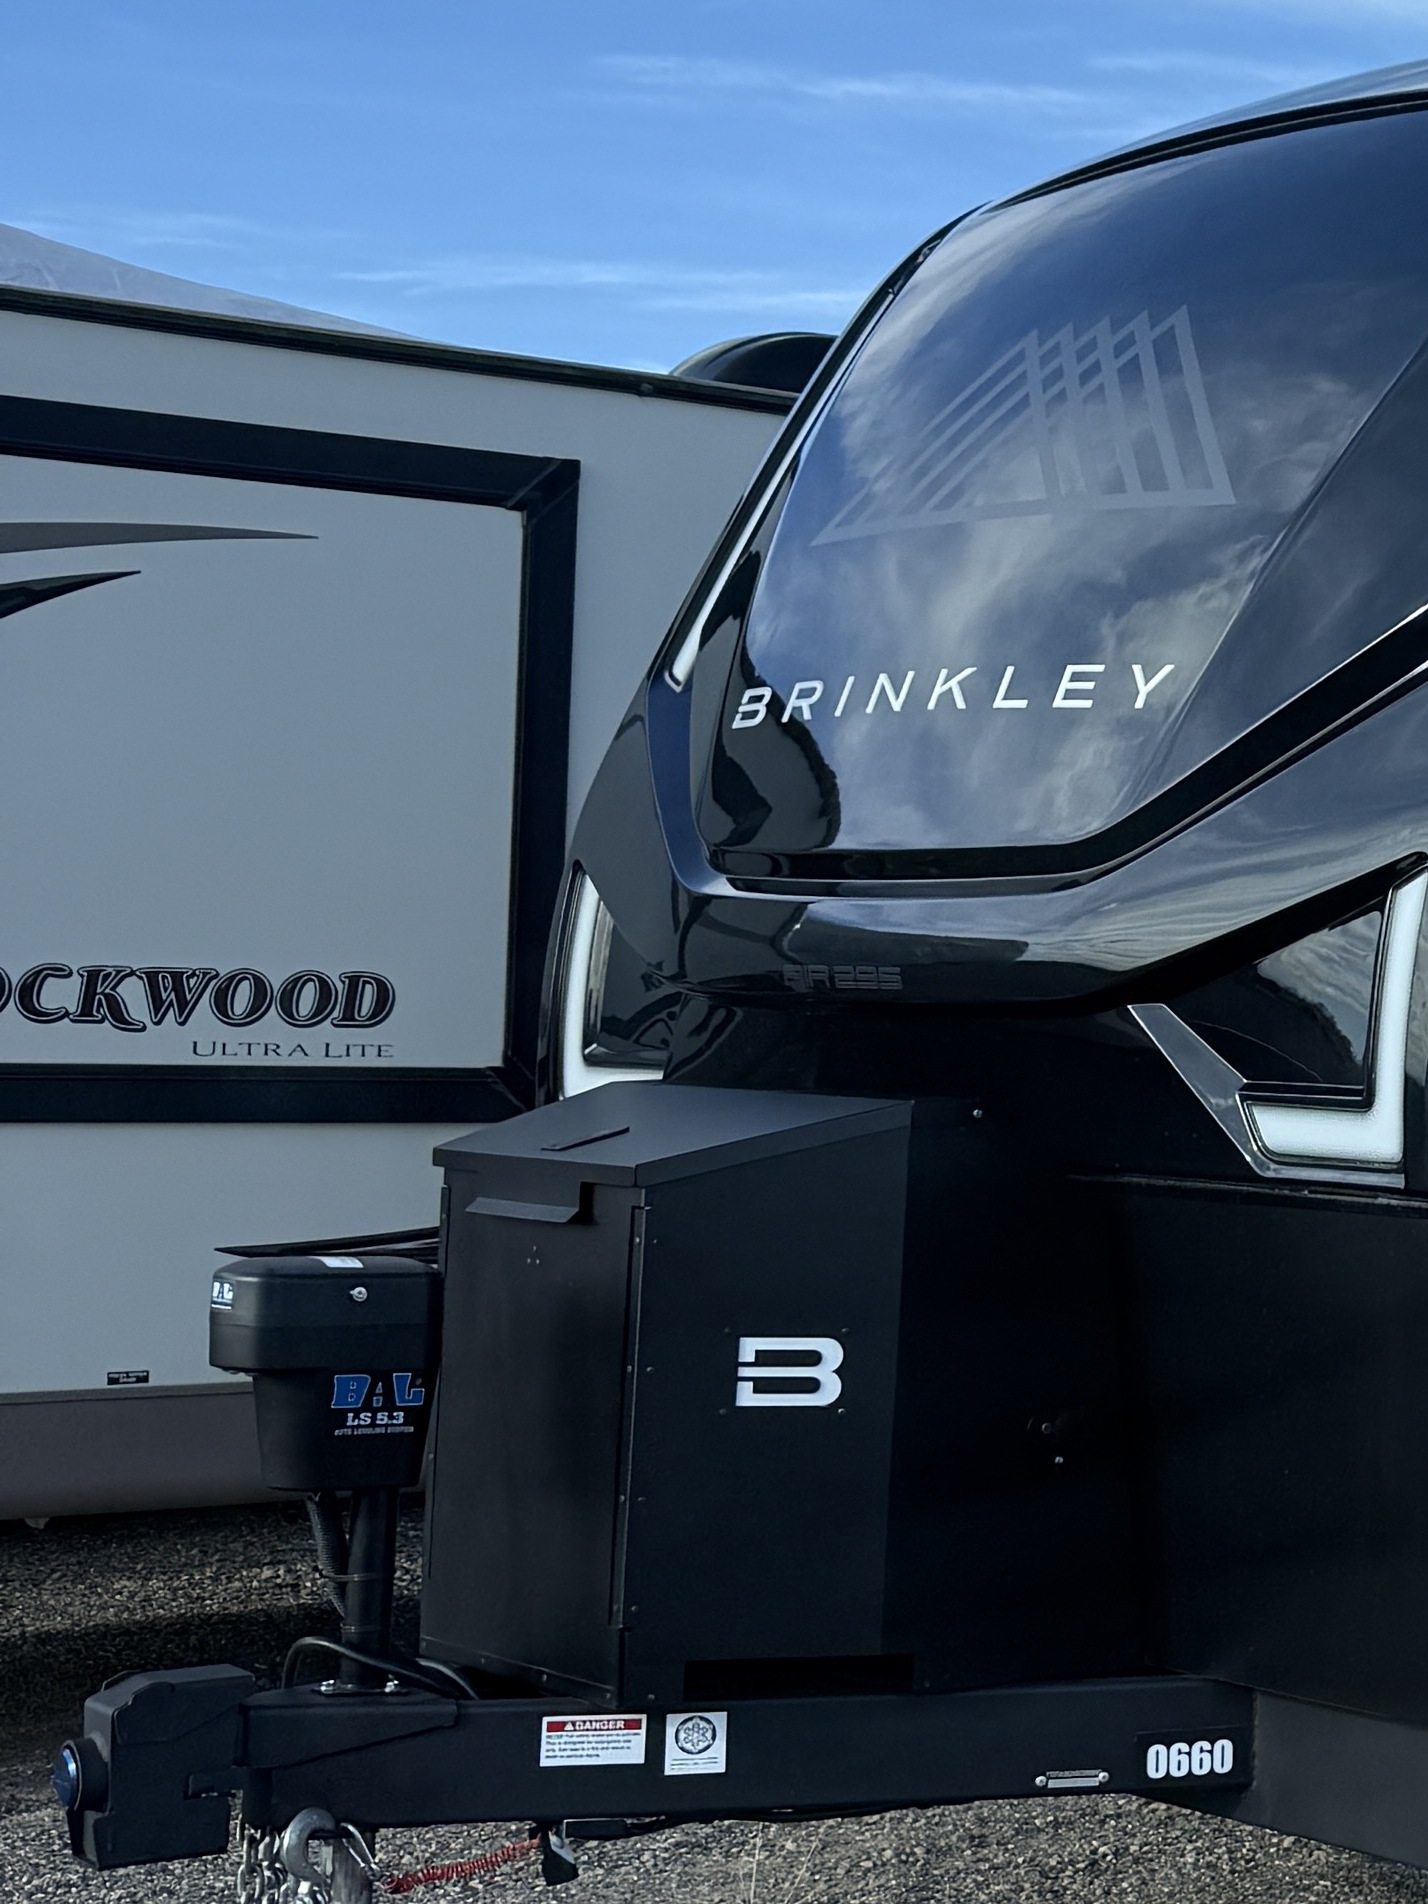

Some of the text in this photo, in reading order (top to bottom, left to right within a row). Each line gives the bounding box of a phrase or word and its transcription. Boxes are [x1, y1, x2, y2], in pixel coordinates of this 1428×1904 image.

[732, 664, 1175, 729] BRINKLEY
[0, 963, 396, 1032] CKWOOD
[191, 1041, 394, 1059] ULTRA LITE
[346, 1412, 372, 1426] LS
[575, 1719, 626, 1731] DANGER
[1146, 1739, 1234, 1779] 0660
